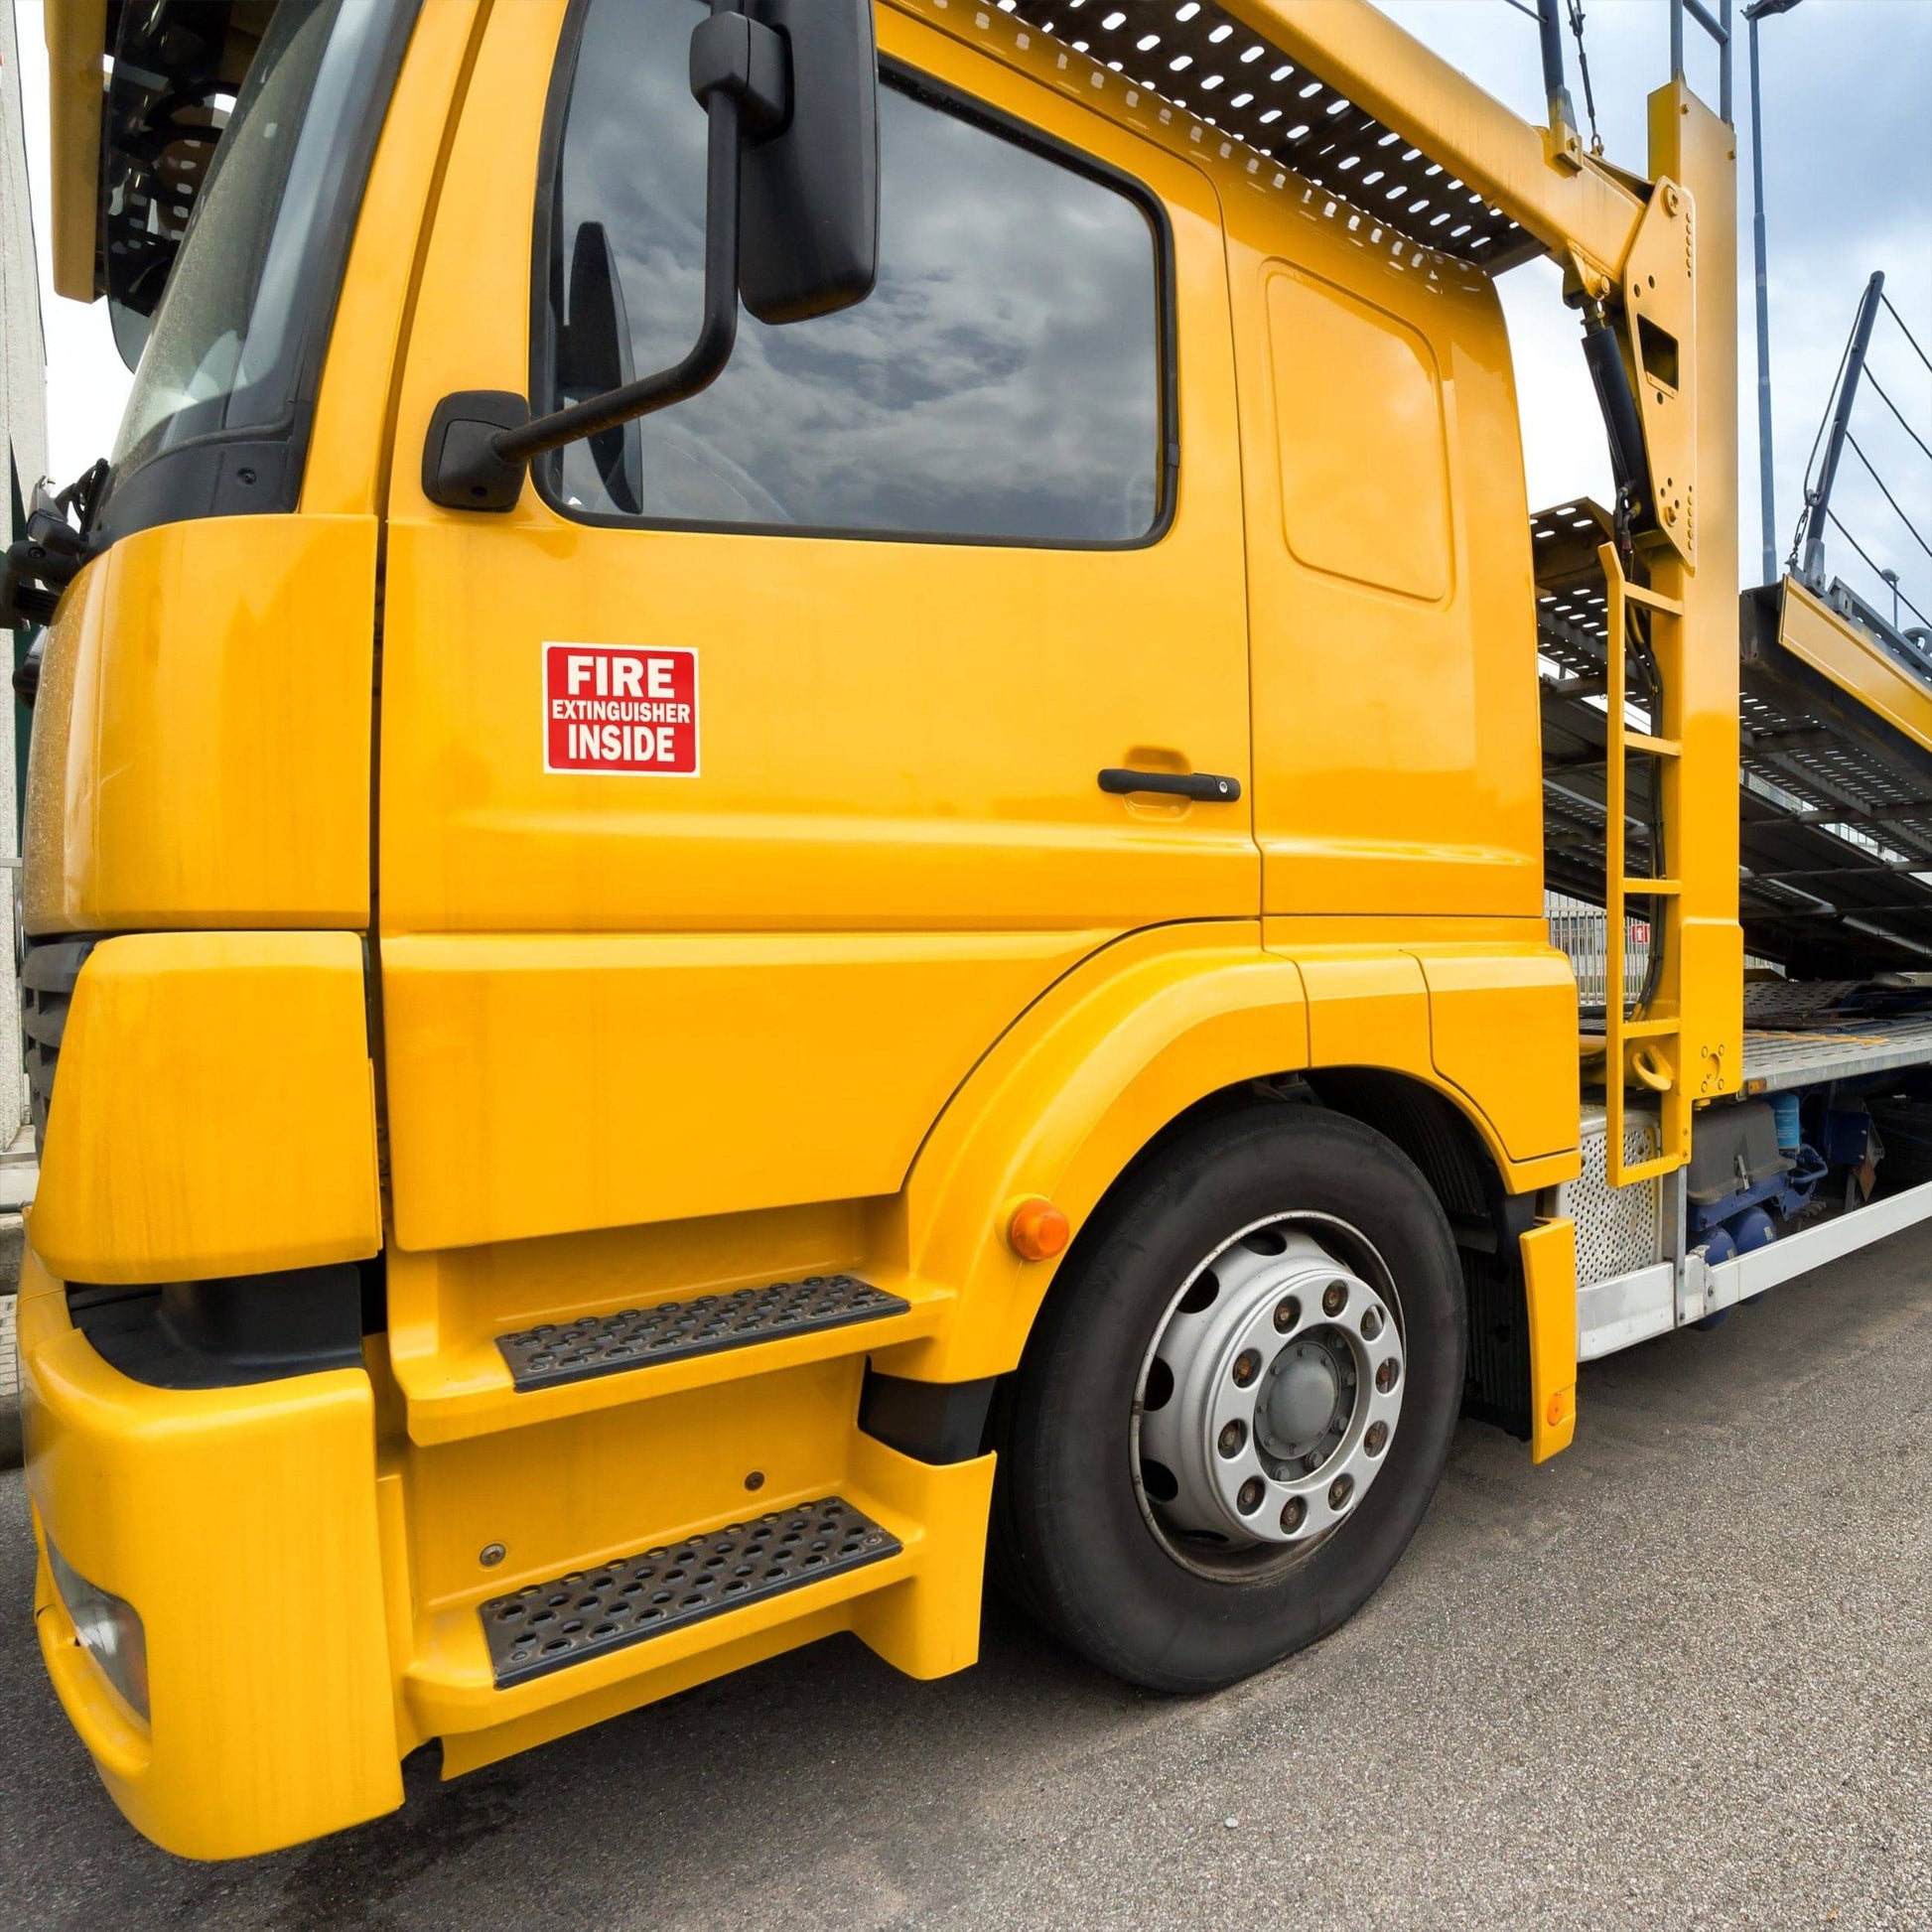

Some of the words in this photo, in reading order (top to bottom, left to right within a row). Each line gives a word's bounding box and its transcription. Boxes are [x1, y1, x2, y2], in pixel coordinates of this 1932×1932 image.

[567, 655, 675, 699] FIRE
[552, 699, 691, 724] EXTINGUISHER
[568, 724, 675, 762] INSIDE
